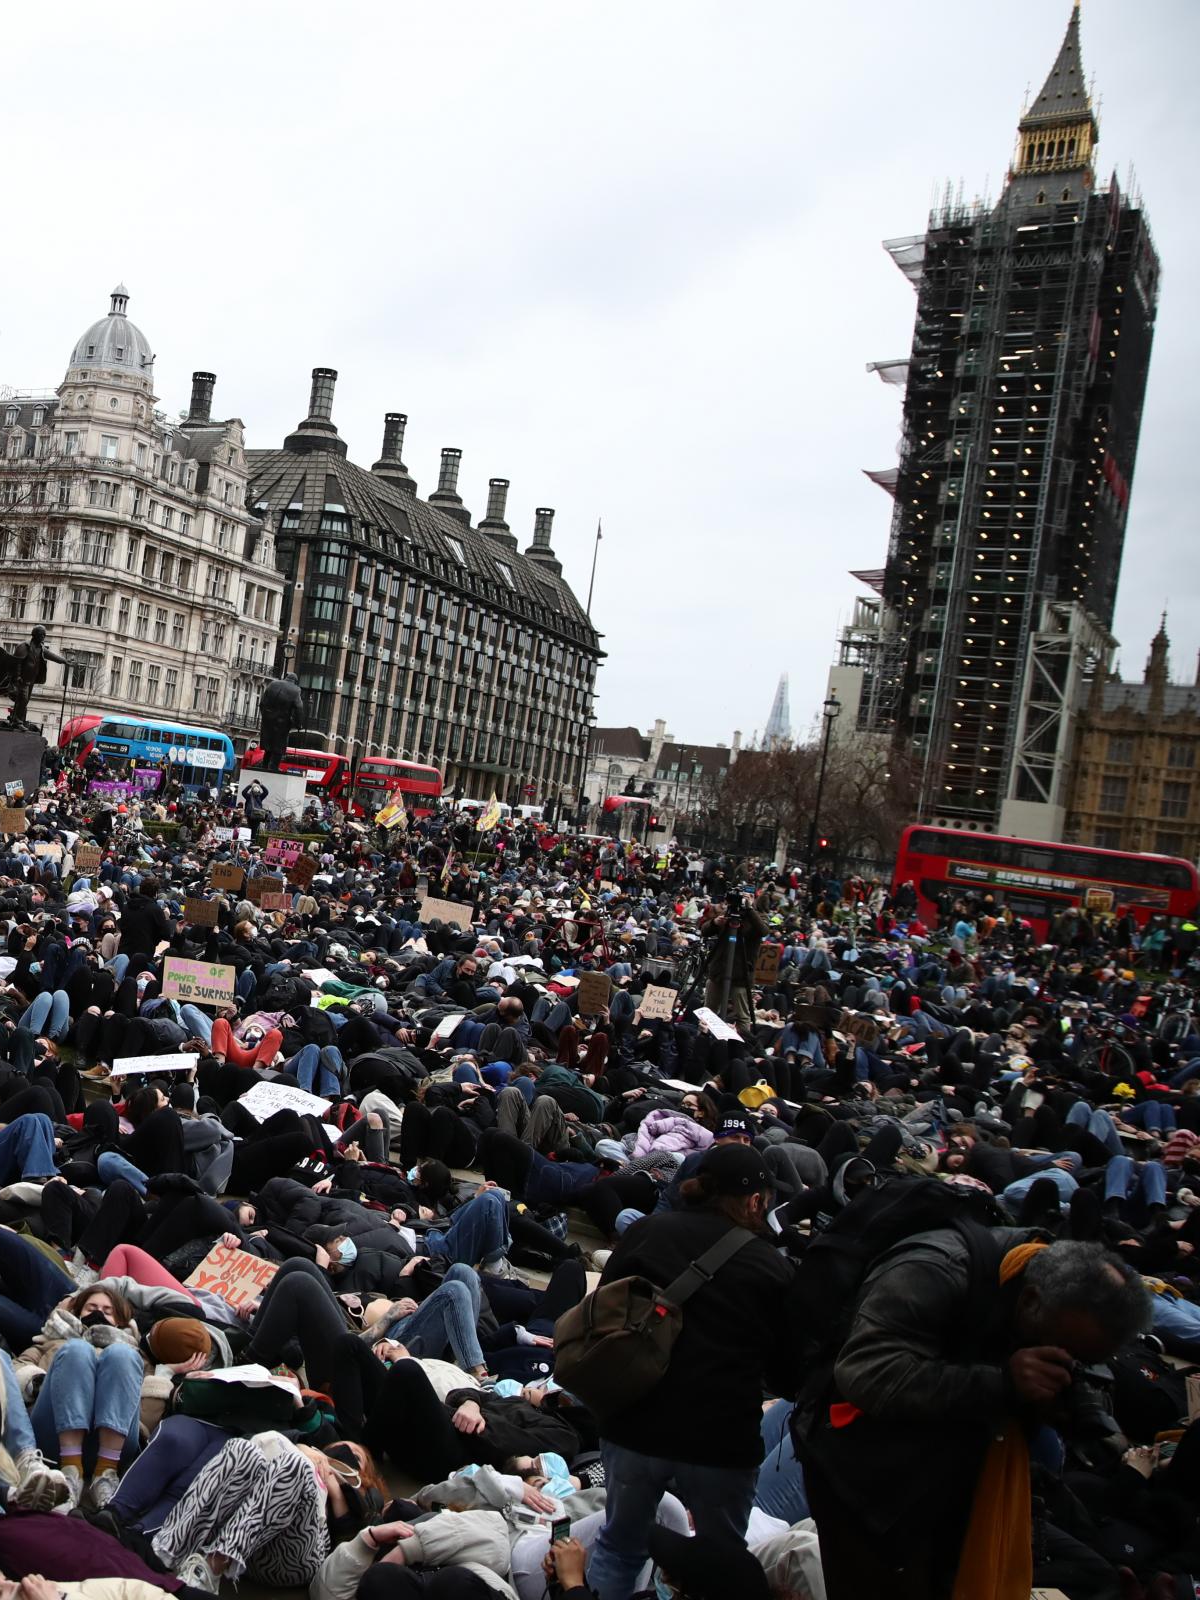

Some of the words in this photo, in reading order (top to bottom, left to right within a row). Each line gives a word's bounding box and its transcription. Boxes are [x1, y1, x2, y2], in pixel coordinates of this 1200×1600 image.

[119, 745, 128, 753] 159
[277, 849, 286, 857] IS
[214, 867, 233, 877] END
[167, 971, 197, 983] POWER
[210, 967, 226, 978] OF
[179, 983, 192, 995] NO
[649, 989, 675, 999] KILL
[645, 1006, 669, 1014] BILL
[284, 1091, 316, 1111] POWER
[723, 1119, 746, 1130] 1994
[206, 1245, 278, 1288] SHAME
[220, 1270, 240, 1285] ON
[195, 1270, 249, 1307] YOU
